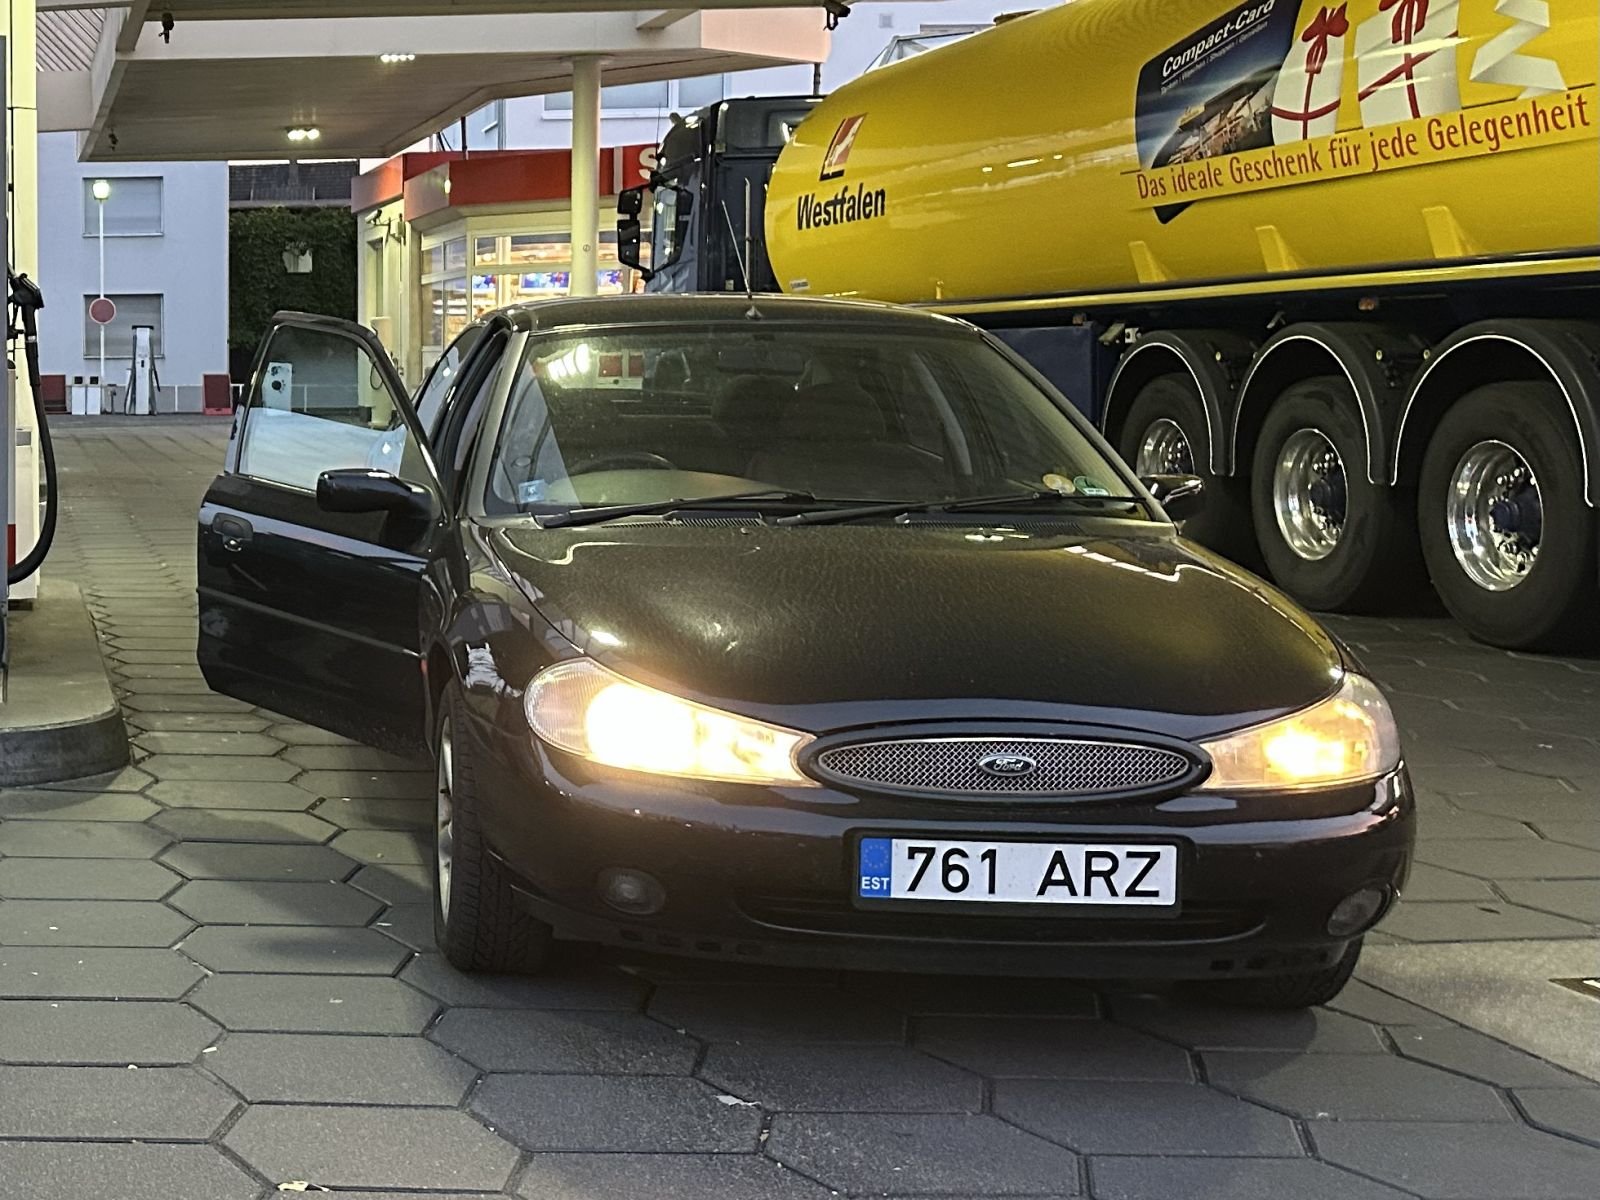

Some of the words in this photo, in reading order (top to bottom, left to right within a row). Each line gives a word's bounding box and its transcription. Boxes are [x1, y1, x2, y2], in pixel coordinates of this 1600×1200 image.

[1162, 0, 1276, 77] Compact-Card
[1137, 173, 1167, 199] Das
[1171, 162, 1223, 194] ideale
[1229, 143, 1322, 184] Geschenk
[1328, 138, 1361, 169] für
[1369, 126, 1419, 171] jede
[1427, 93, 1590, 152] Gelegenheit
[796, 182, 886, 230] Westfalen
[993, 758, 1024, 771] Ford
[861, 876, 890, 890] EST
[906, 846, 997, 895] 761
[1036, 850, 1162, 898] ARZ
